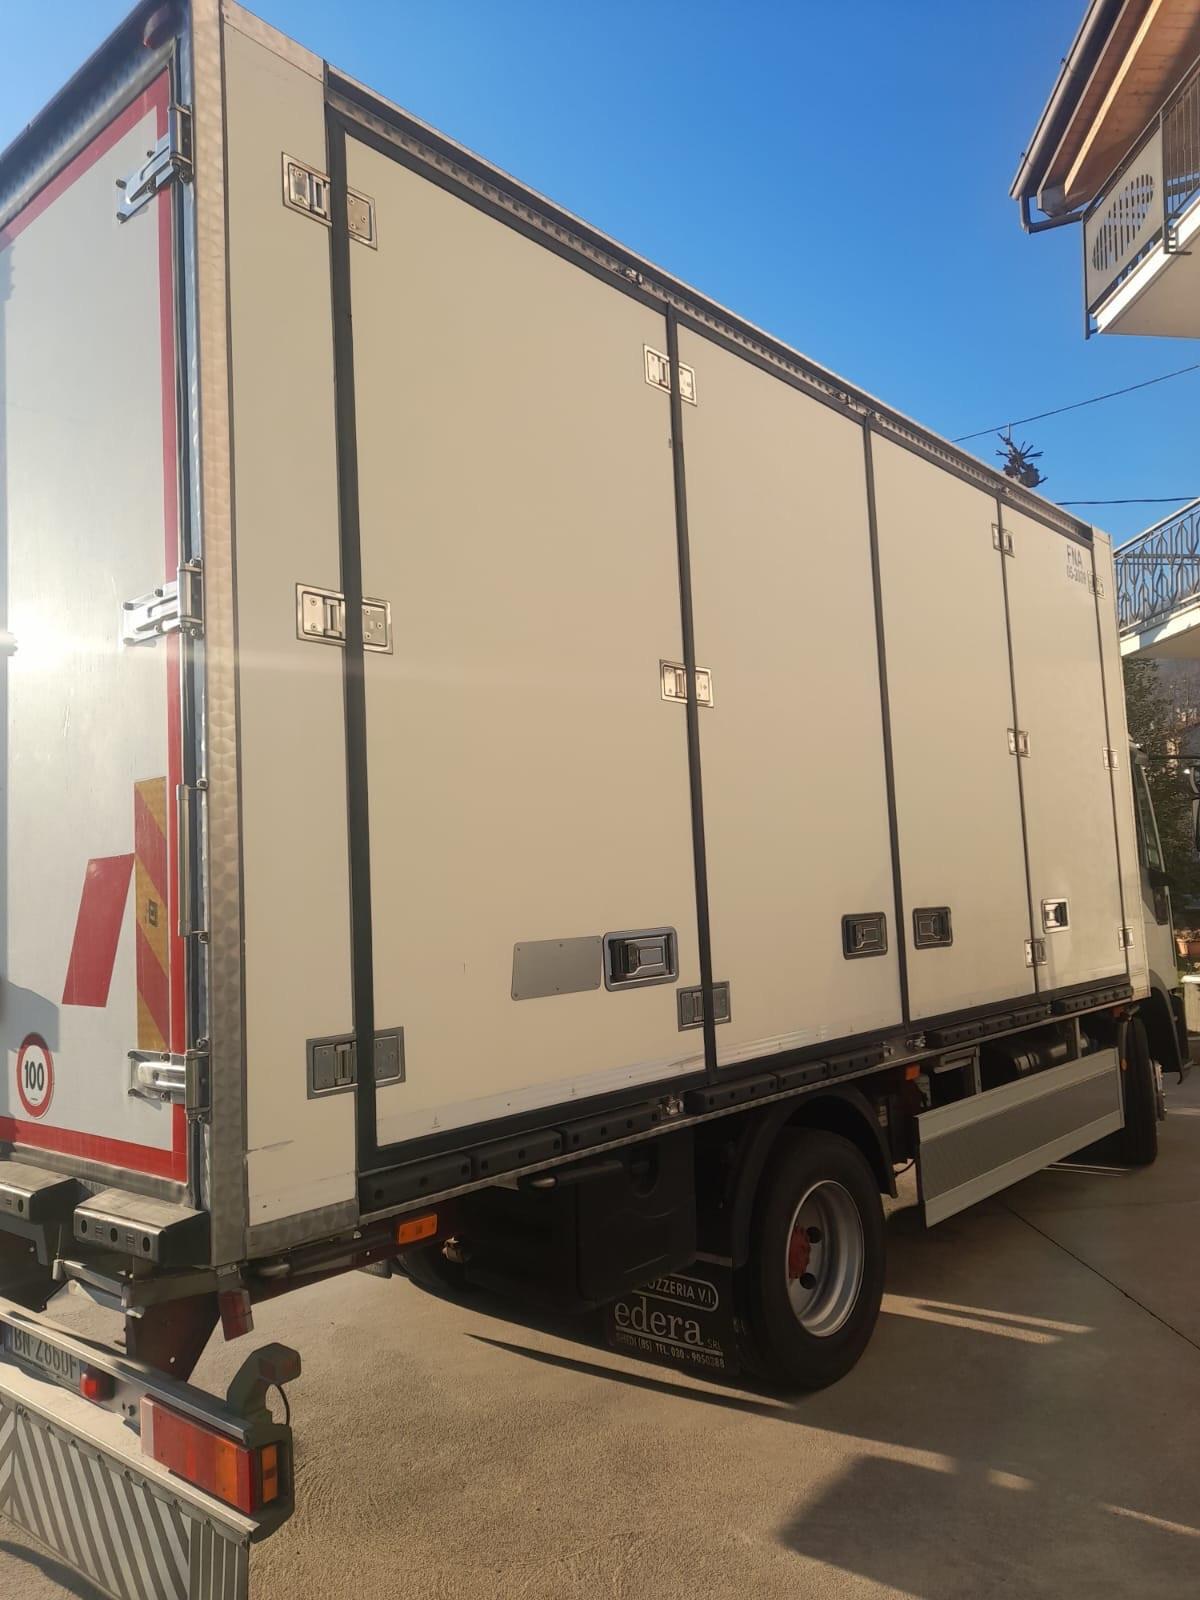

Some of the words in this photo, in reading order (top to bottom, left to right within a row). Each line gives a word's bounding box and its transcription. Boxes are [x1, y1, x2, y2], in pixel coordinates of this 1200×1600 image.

[1066, 543, 1084, 570] FNA
[25, 1060, 45, 1091] 100
[646, 1278, 695, 1300] OZZERIA
[614, 1296, 704, 1346] edera
